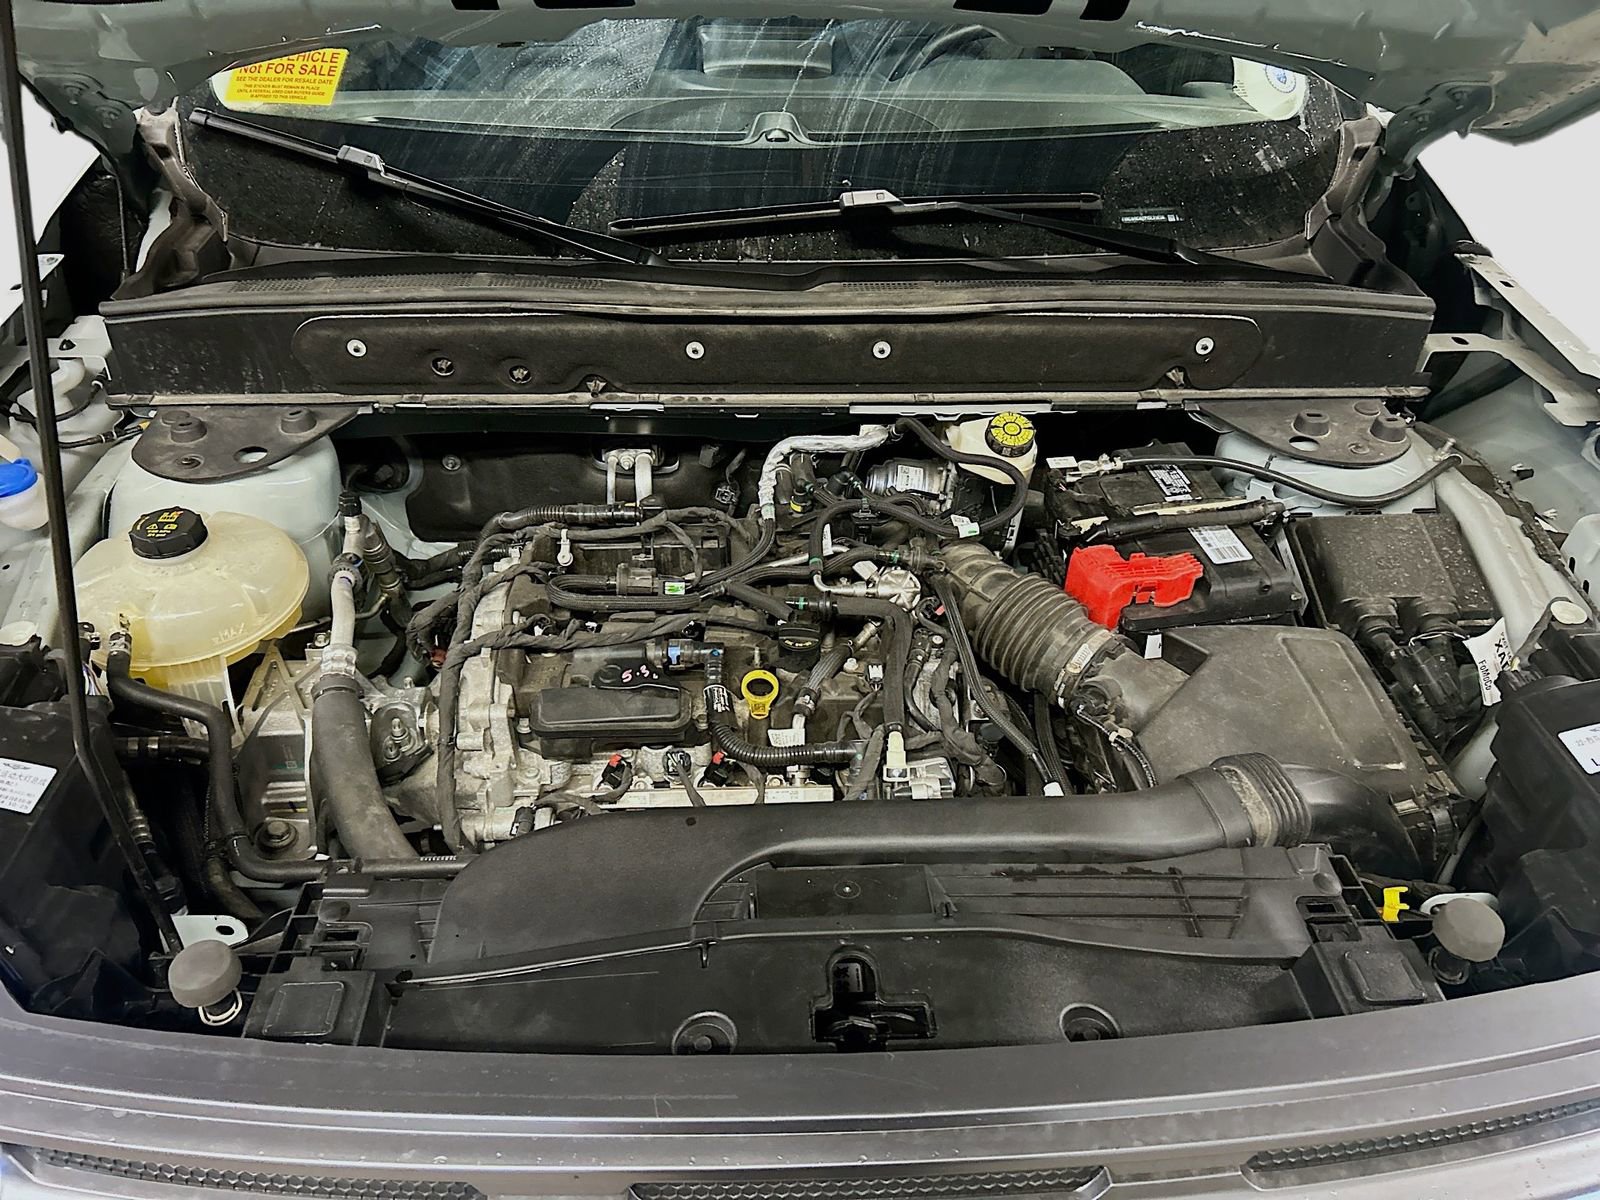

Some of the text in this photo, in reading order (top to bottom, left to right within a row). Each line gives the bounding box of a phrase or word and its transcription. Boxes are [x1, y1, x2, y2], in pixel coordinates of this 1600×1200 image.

[281, 51, 341, 63] EHICLE
[265, 62, 294, 75] FOR
[298, 64, 338, 77] SALE
[1478, 659, 1492, 691] FoMoCo
